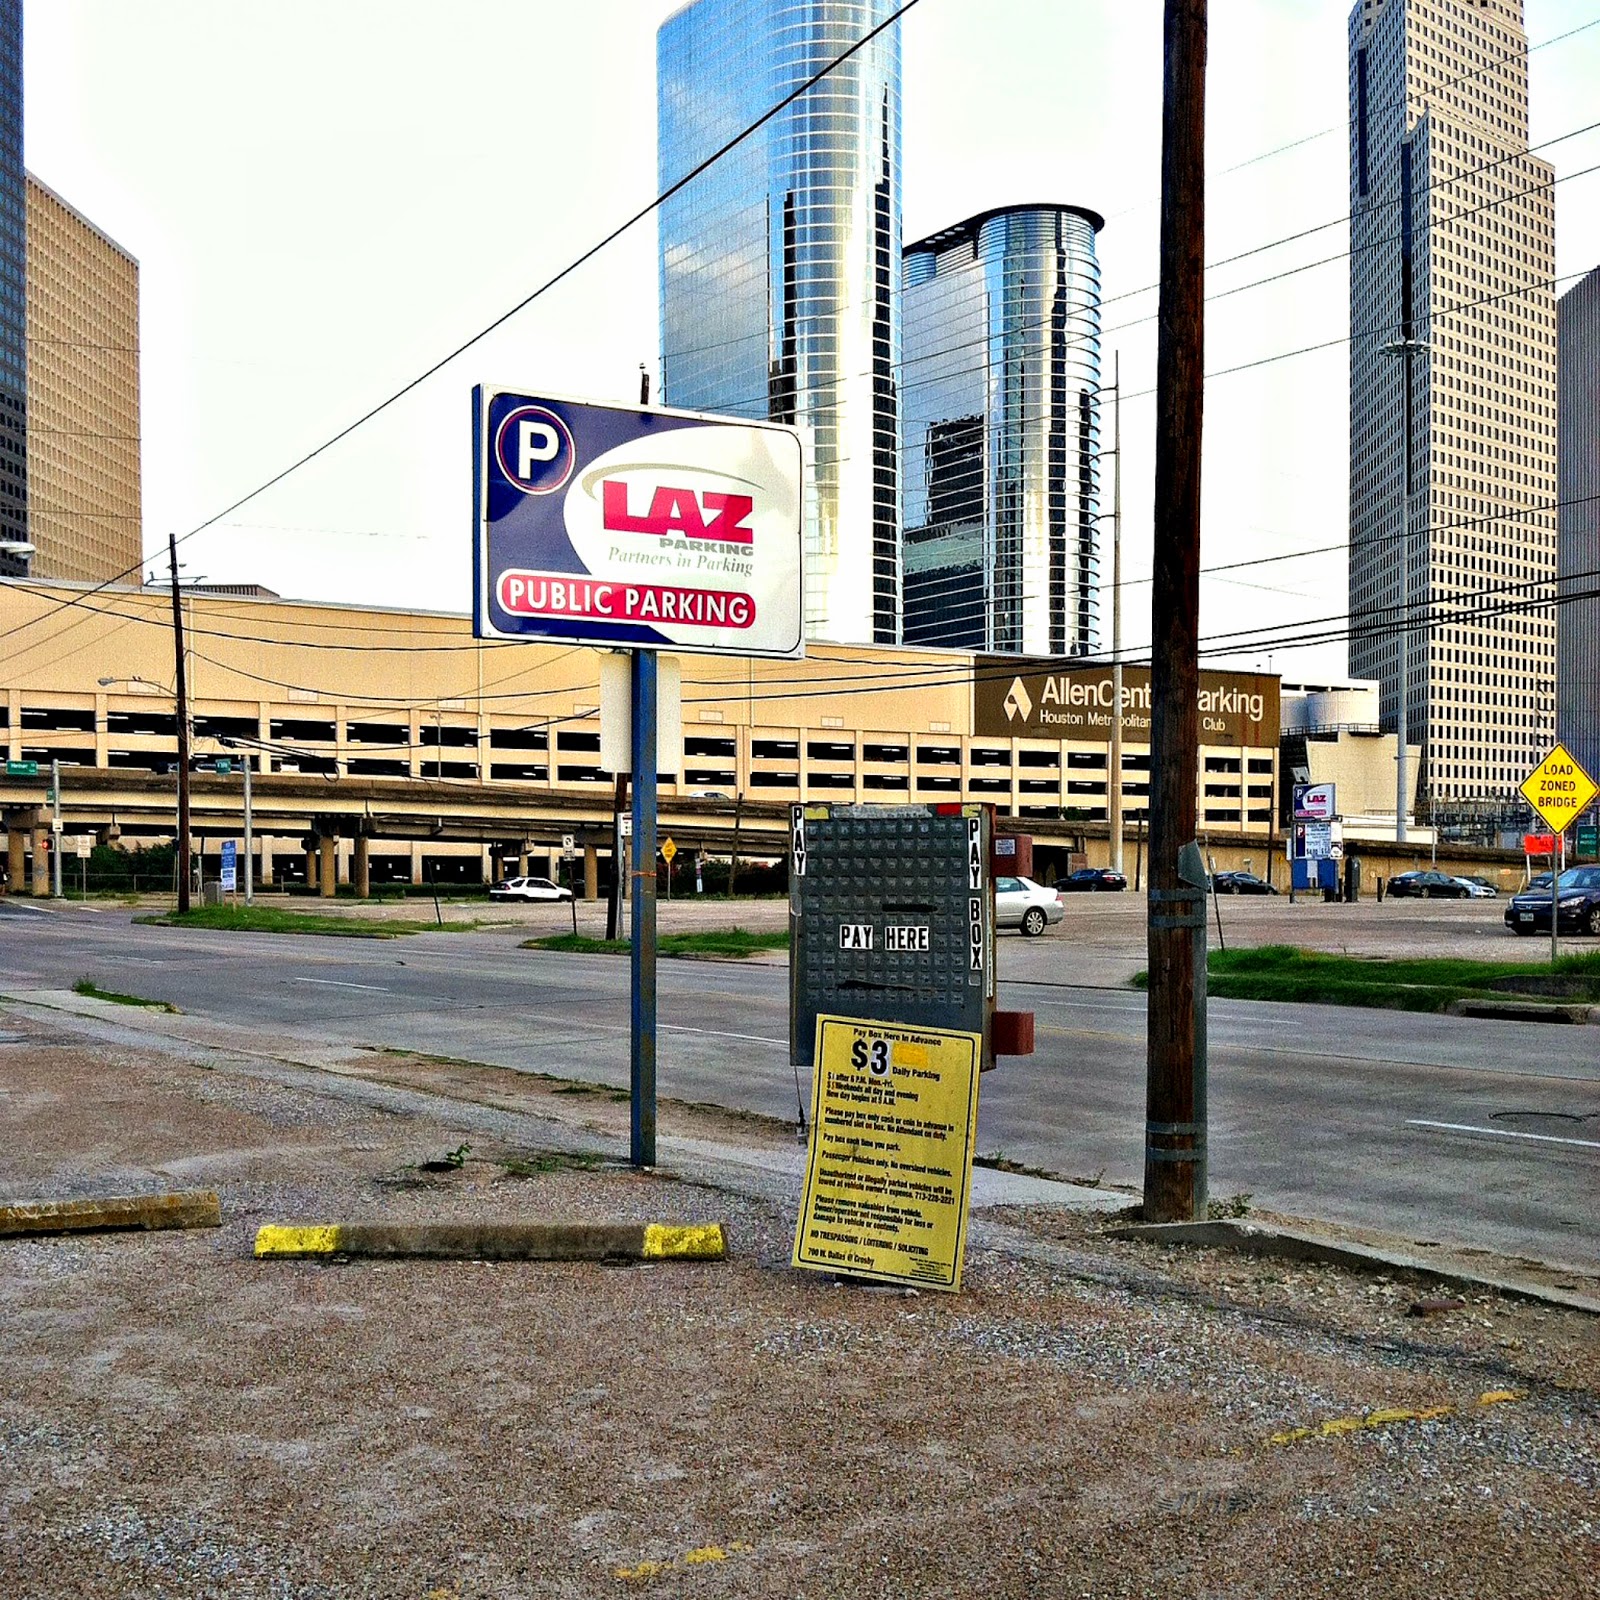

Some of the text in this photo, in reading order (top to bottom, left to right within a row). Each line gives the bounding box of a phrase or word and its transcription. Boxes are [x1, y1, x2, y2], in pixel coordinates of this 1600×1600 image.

[517, 420, 559, 480] P
[603, 480, 753, 544] LAZ
[659, 538, 754, 557] PARKING
[608, 546, 753, 578] Partners in Parking
[509, 578, 749, 624] PUBLIC PARKING
[1041, 676, 1264, 721] AllenCent arking
[1039, 709, 1226, 731] Houston Metrpolitan Club
[1544, 764, 1573, 776] LOAD
[1540, 780, 1576, 792] ZONED
[1538, 796, 1578, 808] BRIDGE
[794, 806, 806, 875] PAY
[969, 818, 982, 969] PAY BOX
[841, 925, 929, 949] PAY HERE
[854, 1028, 865, 1037] Pay
[869, 1030, 881, 1038] Box
[884, 1032, 900, 1040] Here
[911, 1035, 941, 1045] Advance
[851, 1039, 888, 1075] $3
[892, 1066, 940, 1081] Daily Parking
[896, 1090, 918, 1101] evening
[826, 1106, 843, 1115] Please
[845, 1110, 854, 1119] pay
[824, 1133, 833, 1142] Pay
[835, 1134, 845, 1143] box
[875, 1141, 884, 1150] you
[822, 1150, 850, 1162] Passenger
[816, 1194, 834, 1204] Please
